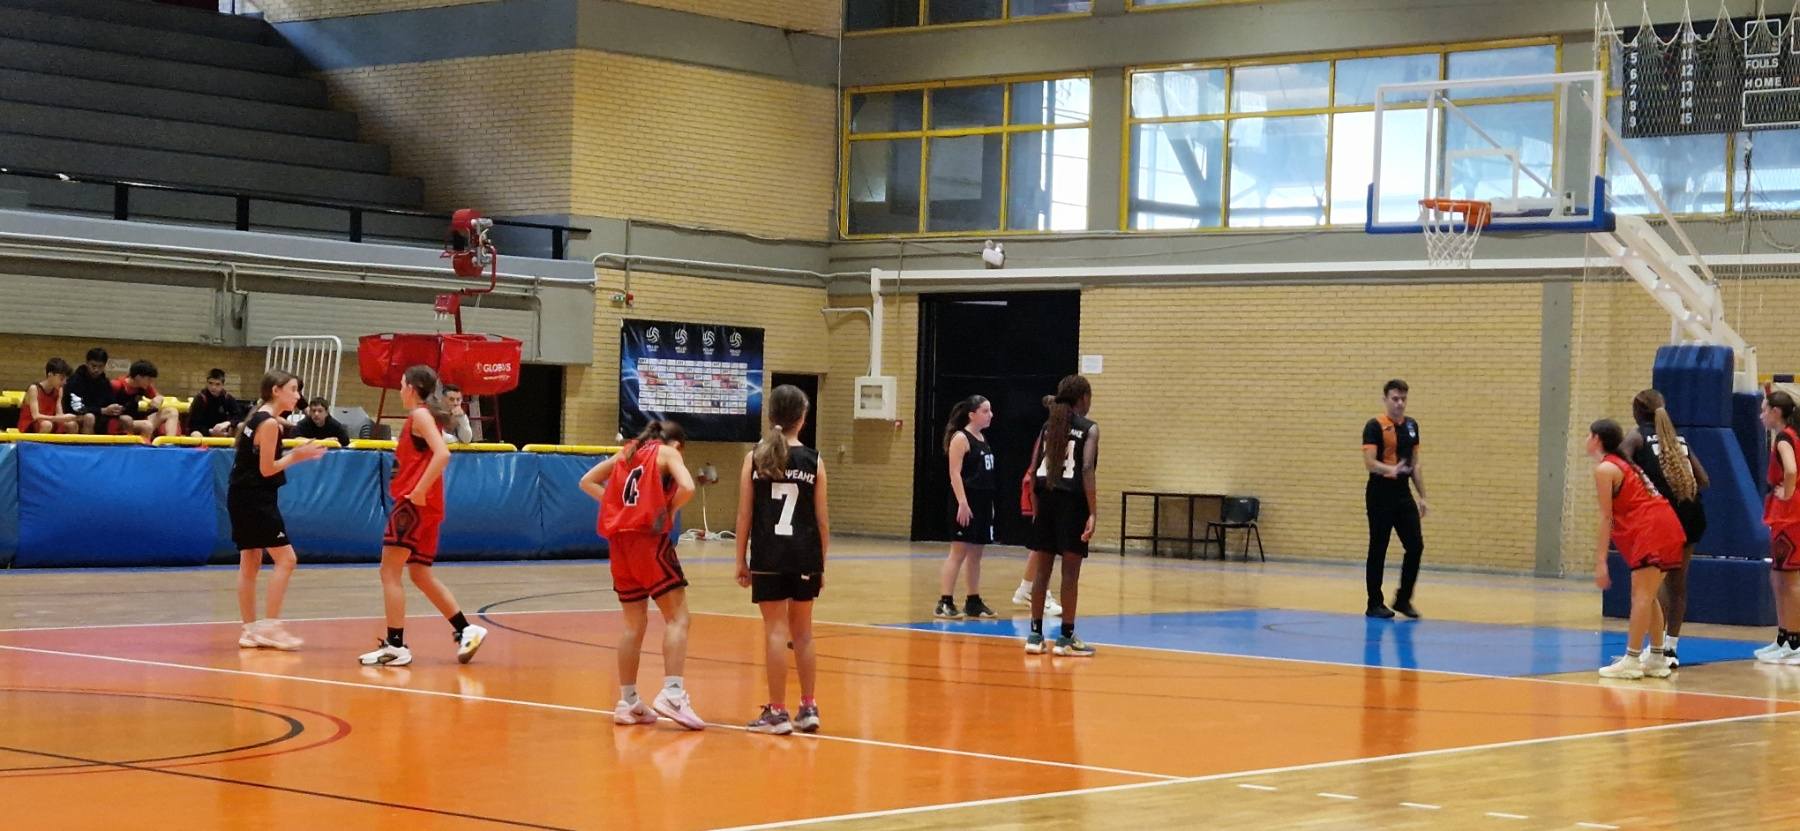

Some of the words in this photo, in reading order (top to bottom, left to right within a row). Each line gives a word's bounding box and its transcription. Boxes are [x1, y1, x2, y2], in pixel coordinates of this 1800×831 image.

[1682, 32, 1694, 44] 10
[1630, 52, 1638, 64] 5
[1681, 48, 1692, 60] 11
[1681, 64, 1693, 76] 12
[1745, 58, 1779, 70] FOULS
[1630, 69, 1637, 80] 6
[1681, 81, 1693, 93] 13
[1744, 77, 1782, 88] HOME
[1629, 84, 1637, 96] 7
[1629, 100, 1637, 112] 8
[1681, 97, 1693, 109] 14
[1629, 116, 1637, 128] 9
[1681, 112, 1693, 124] 15
[785, 469, 816, 485] ΨΕΛΗΣ
[622, 464, 644, 507] 4
[771, 482, 799, 536] 7
